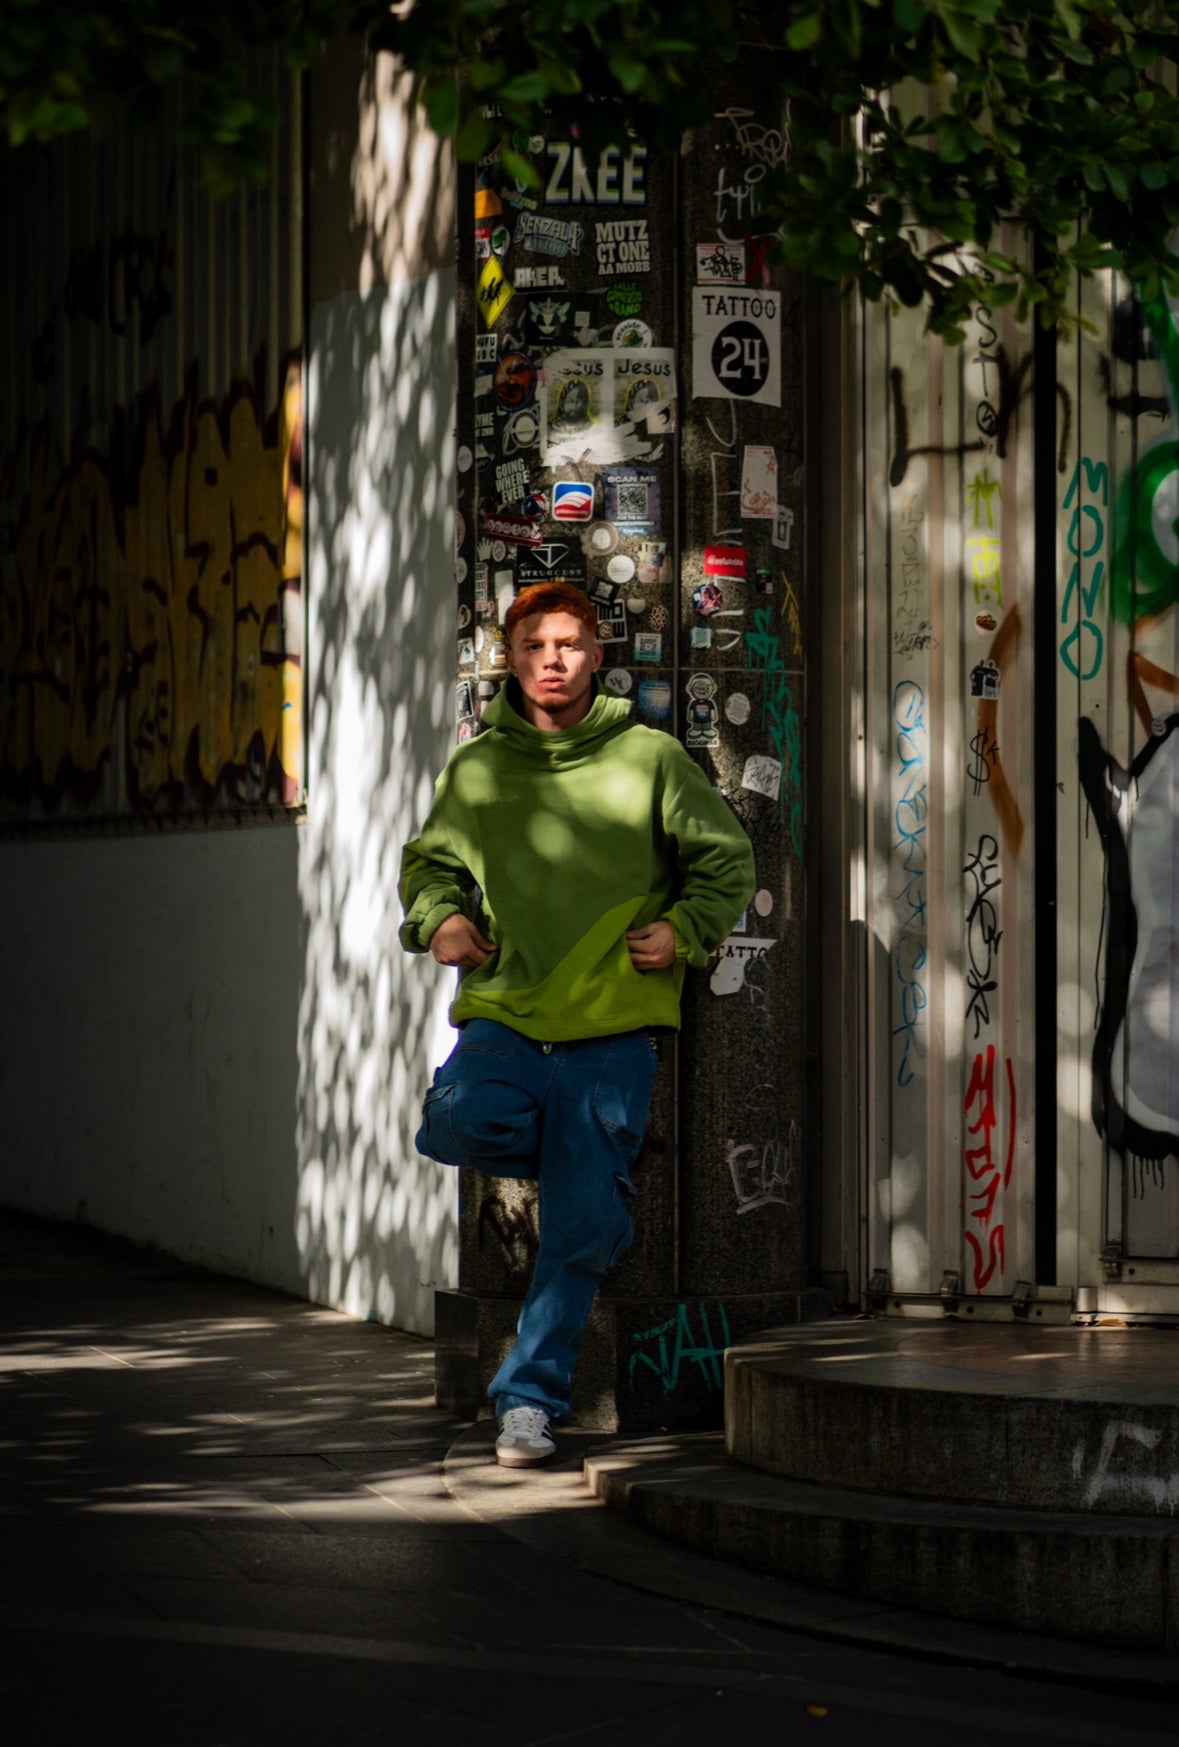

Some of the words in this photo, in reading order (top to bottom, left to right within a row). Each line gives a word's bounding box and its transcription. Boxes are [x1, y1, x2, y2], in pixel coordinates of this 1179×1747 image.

[595, 220, 649, 243] MUTZ
[597, 243, 616, 263] CT
[619, 240, 650, 262] ONE
[598, 263, 614, 275] AA
[616, 261, 651, 274] MOBB
[702, 295, 776, 319] TATTOO
[618, 359, 671, 377] Jesus
[719, 336, 763, 380] 24
[496, 458, 526, 479] GOING
[607, 475, 638, 484] SCAN
[640, 475, 657, 483] ME
[496, 471, 530, 493] WHERE
[502, 486, 525, 505] EVER
[1060, 457, 1108, 680] MONO
